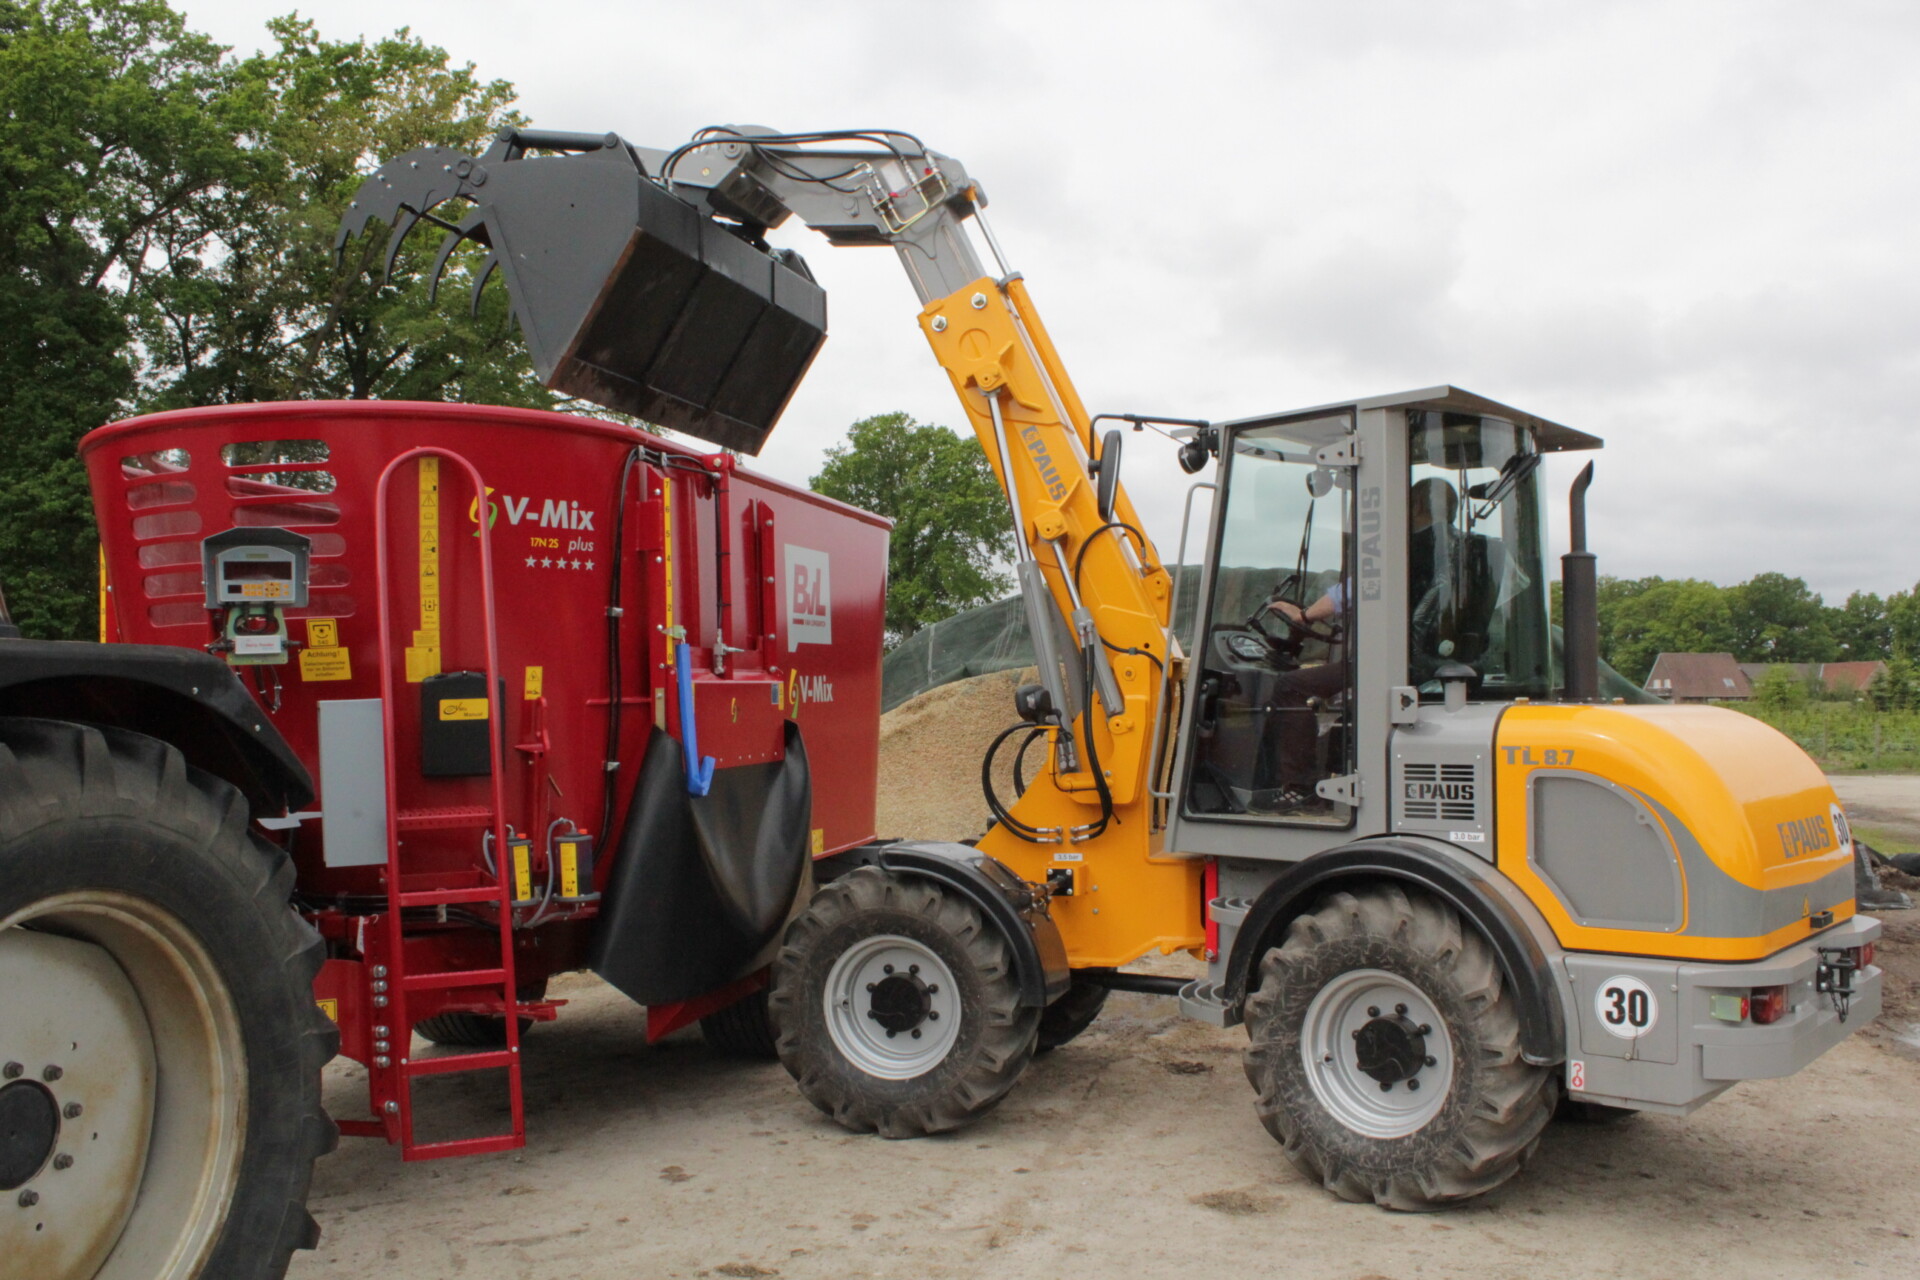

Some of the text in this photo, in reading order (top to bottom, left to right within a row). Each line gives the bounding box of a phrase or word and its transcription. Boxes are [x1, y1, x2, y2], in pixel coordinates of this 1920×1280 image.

[502, 495, 595, 531] V-Mix
[568, 536, 594, 554] plus
[799, 674, 834, 703] V-Mix
[1501, 746, 1575, 765] TL 8.7
[1467, 832, 1480, 841] bar
[1833, 812, 1849, 846] 30
[1605, 987, 1649, 1027] 30
